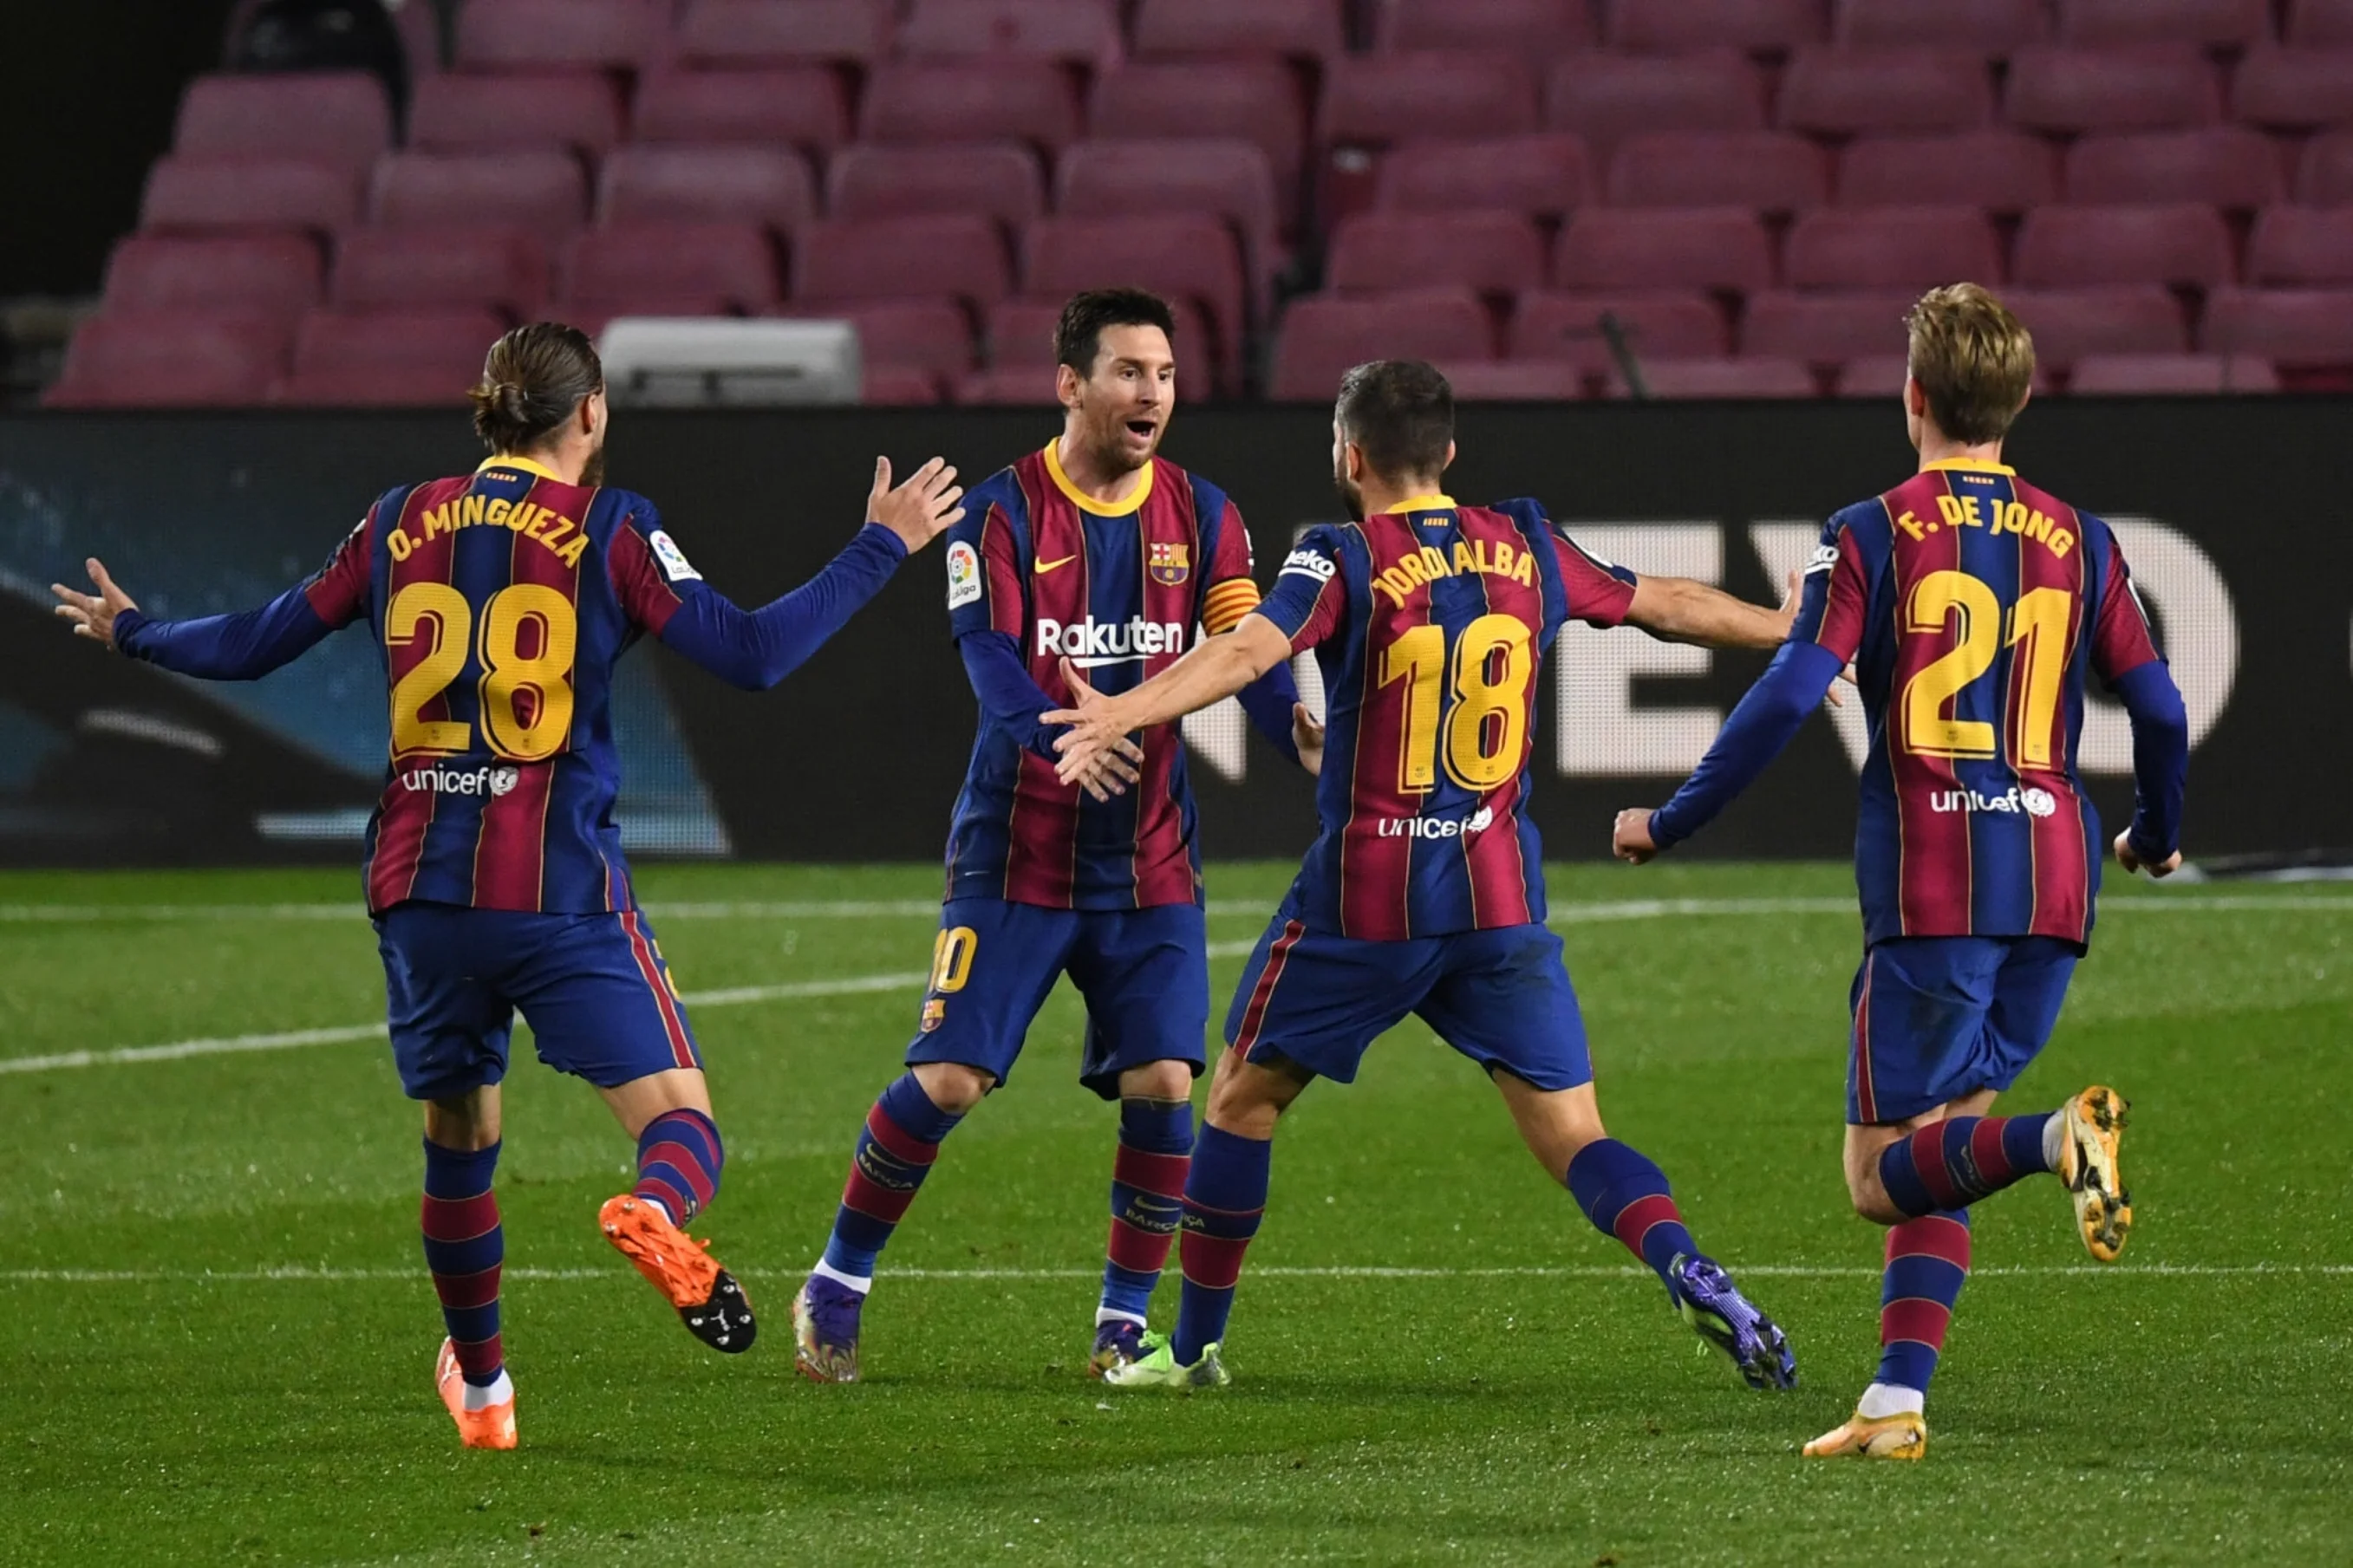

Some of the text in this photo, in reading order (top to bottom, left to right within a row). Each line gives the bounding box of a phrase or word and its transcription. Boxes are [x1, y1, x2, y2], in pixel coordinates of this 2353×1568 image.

[387, 494, 590, 569] O. MINGUEZA
[1899, 495, 2075, 559] F. DE JONG
[1372, 539, 1535, 609] JORDI ALBA
[1037, 615, 1183, 657] Rakuten
[1901, 569, 2072, 770] 21
[385, 582, 577, 761] 28
[1378, 614, 1532, 794] 18
[401, 763, 489, 797] unicef
[1377, 813, 1471, 840] unicef
